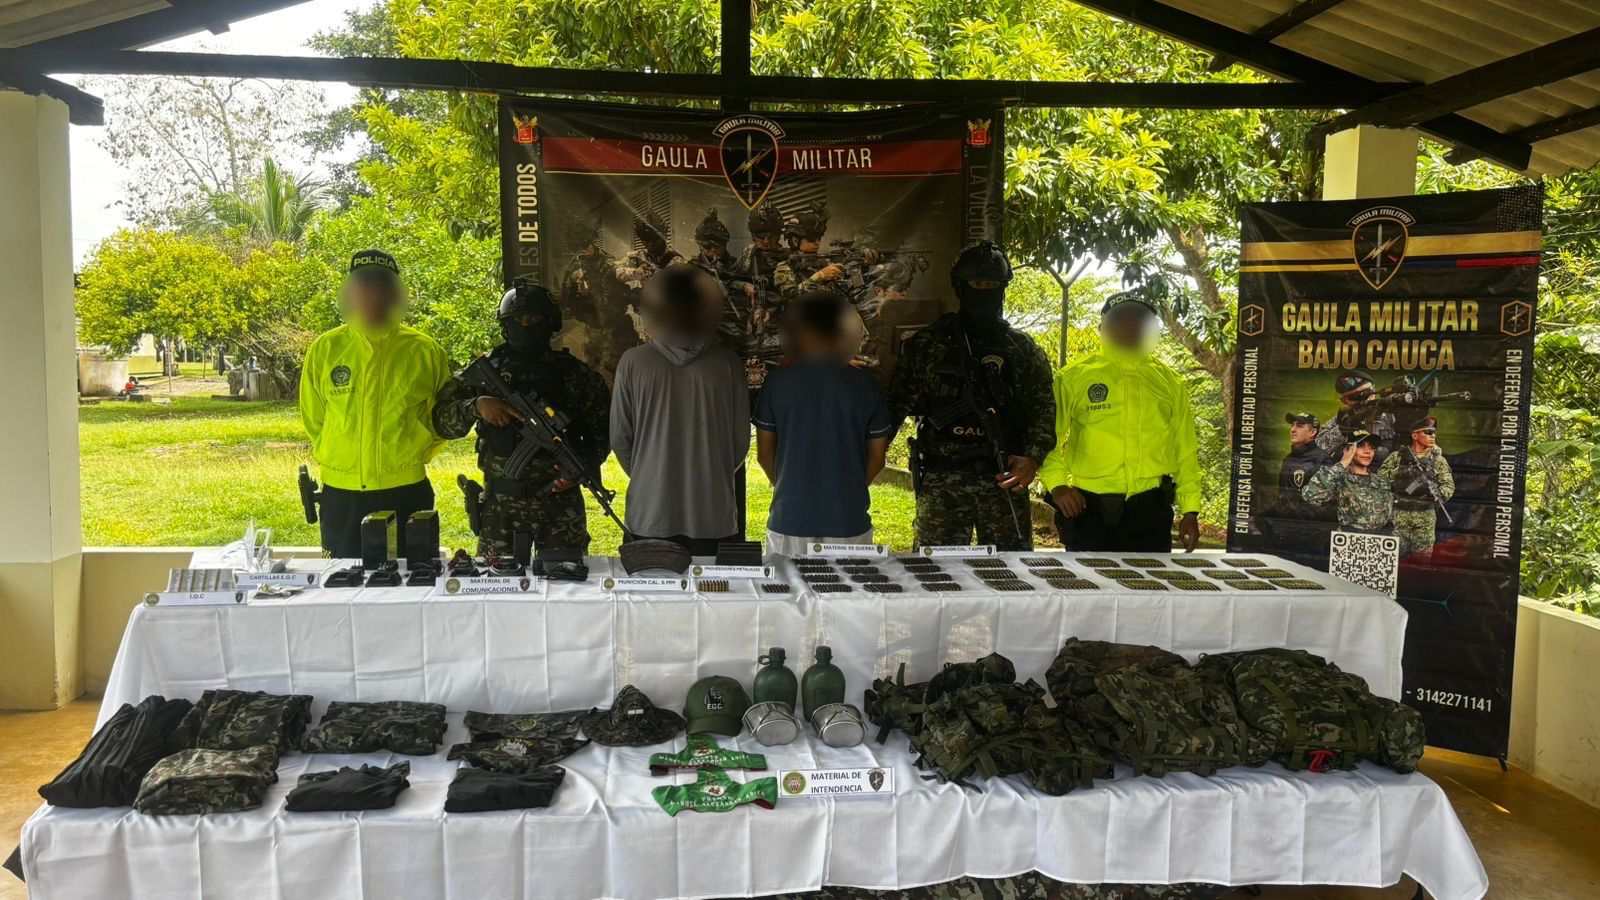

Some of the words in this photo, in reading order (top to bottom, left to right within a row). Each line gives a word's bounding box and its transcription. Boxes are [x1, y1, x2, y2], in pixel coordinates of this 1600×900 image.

[641, 144, 708, 169] GAULA
[793, 147, 873, 170] MILITAR
[516, 163, 539, 217] TODOS
[518, 221, 538, 243] DE
[1282, 302, 1362, 332] GAULA
[1369, 300, 1480, 332] MILITAR
[1298, 339, 1360, 369] BAJO
[1366, 339, 1456, 371] CAUCA
[1506, 349, 1522, 363] EN
[1243, 346, 1258, 395] PERSONAL
[1503, 366, 1521, 412] DEFENSA
[1241, 396, 1256, 441] LIBERTAD
[1502, 415, 1518, 436] POR
[1239, 443, 1255, 455] LA
[1500, 438, 1517, 451] LA
[1239, 457, 1253, 476] POR
[1496, 454, 1515, 503] LIBERTAD
[1236, 478, 1252, 519] DEFENSA
[1234, 520, 1249, 534] EN
[1493, 505, 1512, 559] PERSONAL
[1416, 687, 1492, 713] 3142271141
[811, 772, 850, 780] MATERIAL
[851, 771, 862, 779] DE
[811, 784, 863, 793] INTENDENCIA
